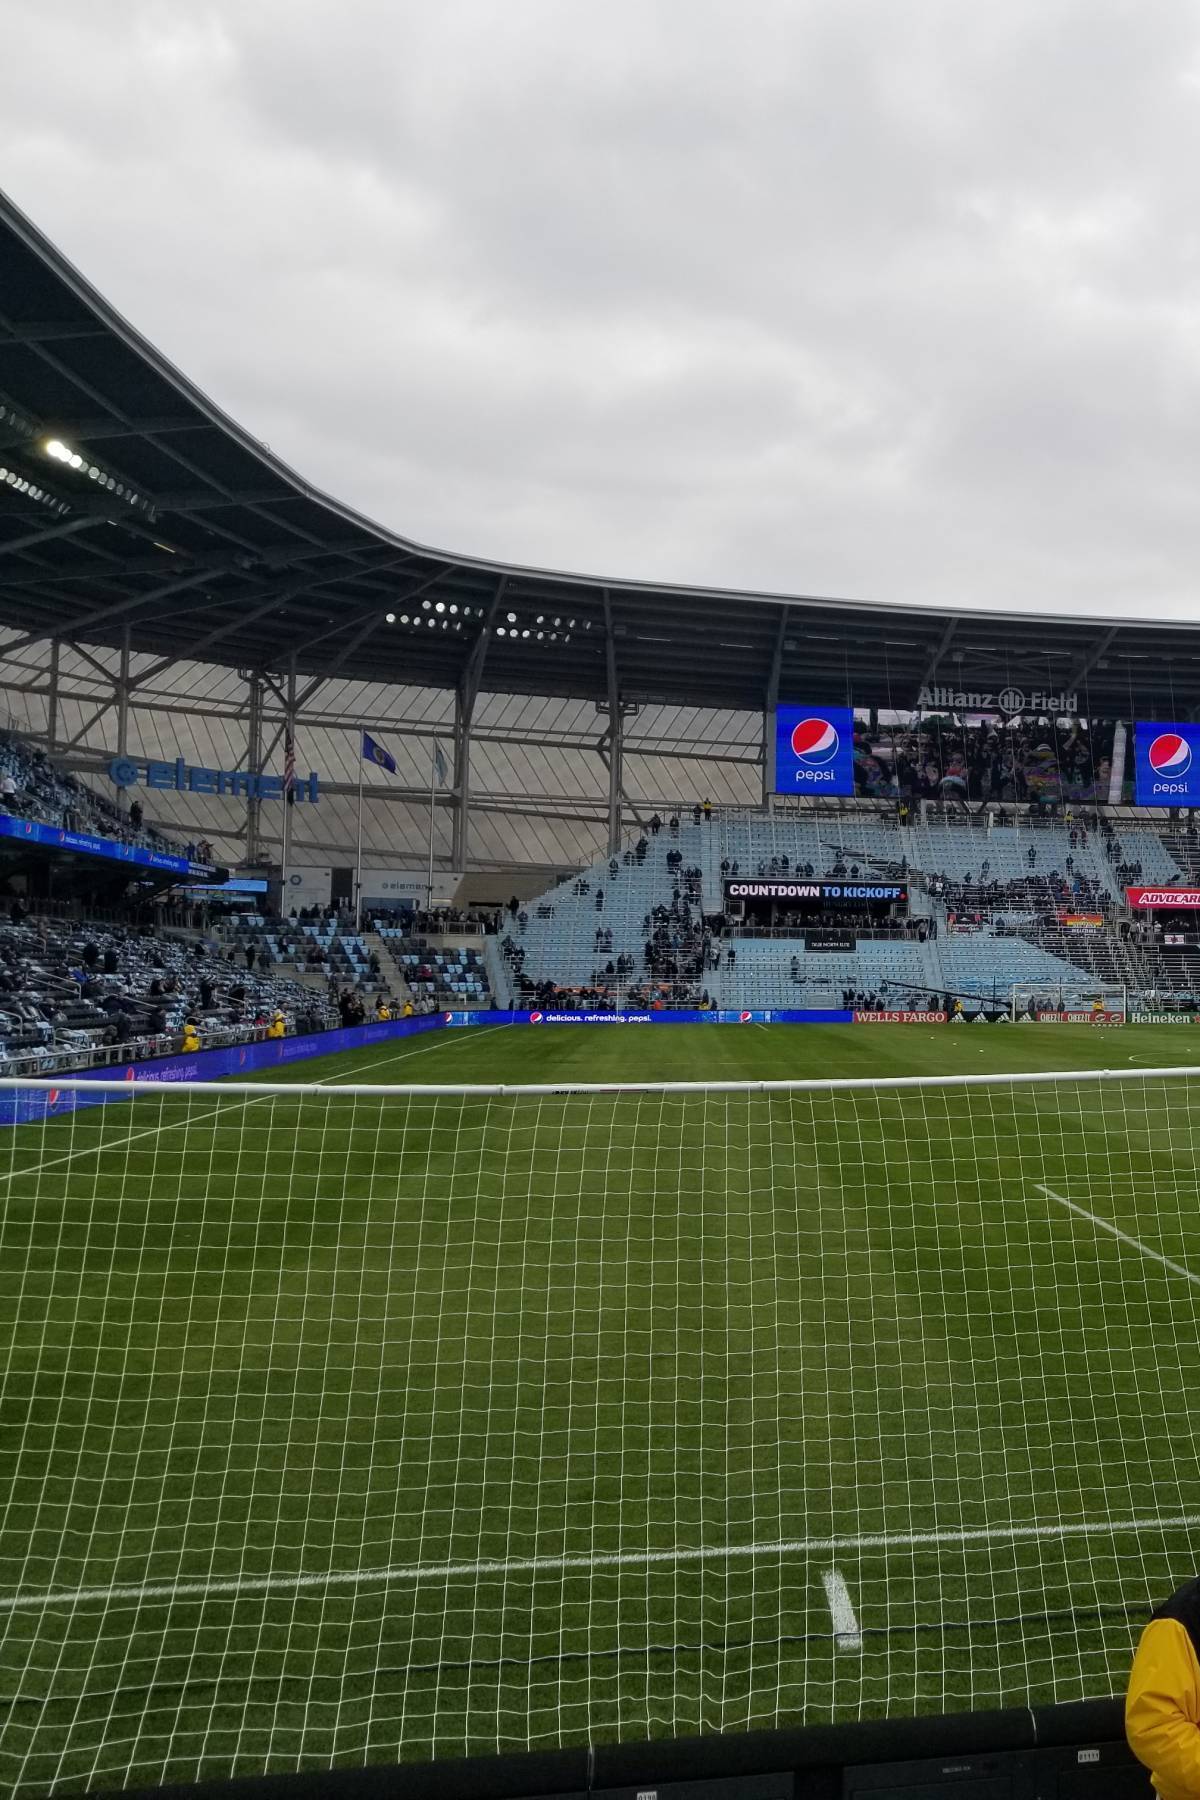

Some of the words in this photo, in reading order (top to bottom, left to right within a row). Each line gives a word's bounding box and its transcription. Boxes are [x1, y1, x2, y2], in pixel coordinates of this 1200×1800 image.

[916, 687, 993, 709] Allianz
[1031, 692, 1078, 712] Field
[796, 769, 835, 782] pepsi
[1152, 782, 1188, 795] pepsi
[730, 885, 820, 897] COUNTDOWN
[823, 886, 840, 897] TO
[856, 1012, 900, 1022] WELLS
[902, 1012, 945, 1022] FARGO
[1131, 1013, 1190, 1024] Heineken
